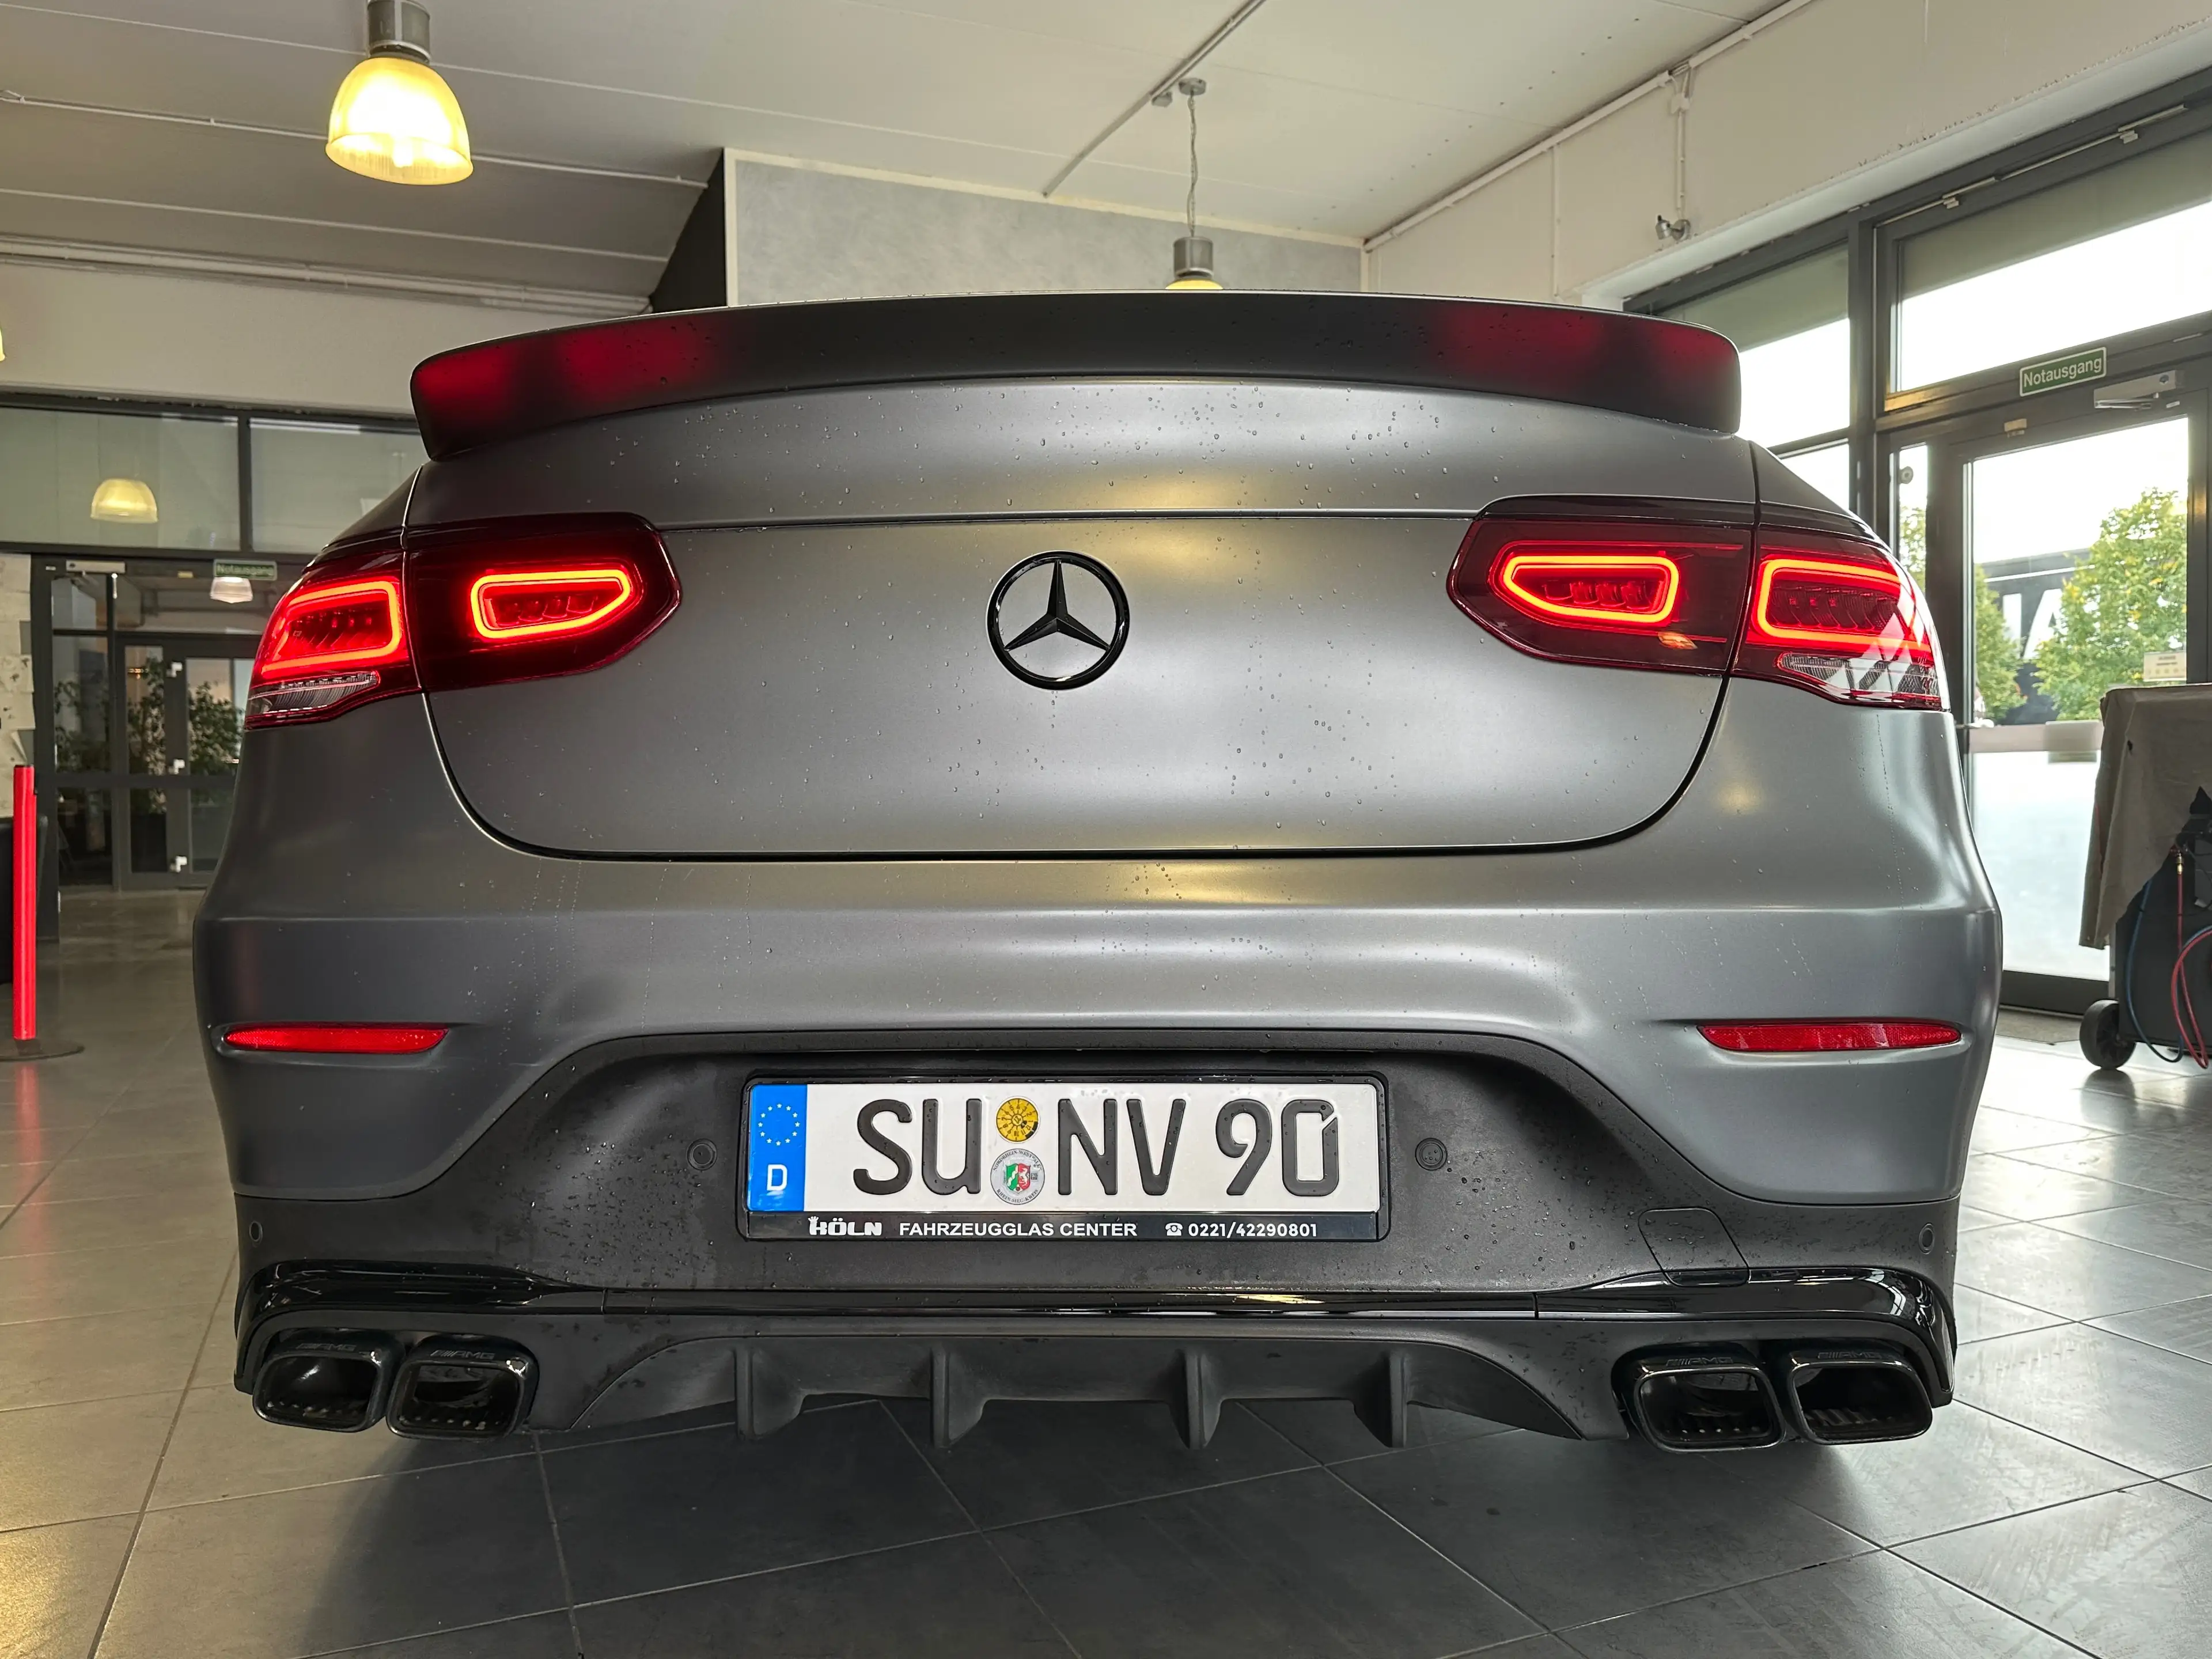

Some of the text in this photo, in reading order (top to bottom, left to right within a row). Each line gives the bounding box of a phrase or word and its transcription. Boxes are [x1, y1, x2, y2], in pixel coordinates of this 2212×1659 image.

[2023, 357, 2103, 388] Notausgang
[853, 1099, 1340, 1196] SU NV 90
[766, 1164, 788, 1192] D
[808, 1216, 1317, 1238] KÖLN FAHRZEUGGLAS CENTER 0221/42290801
